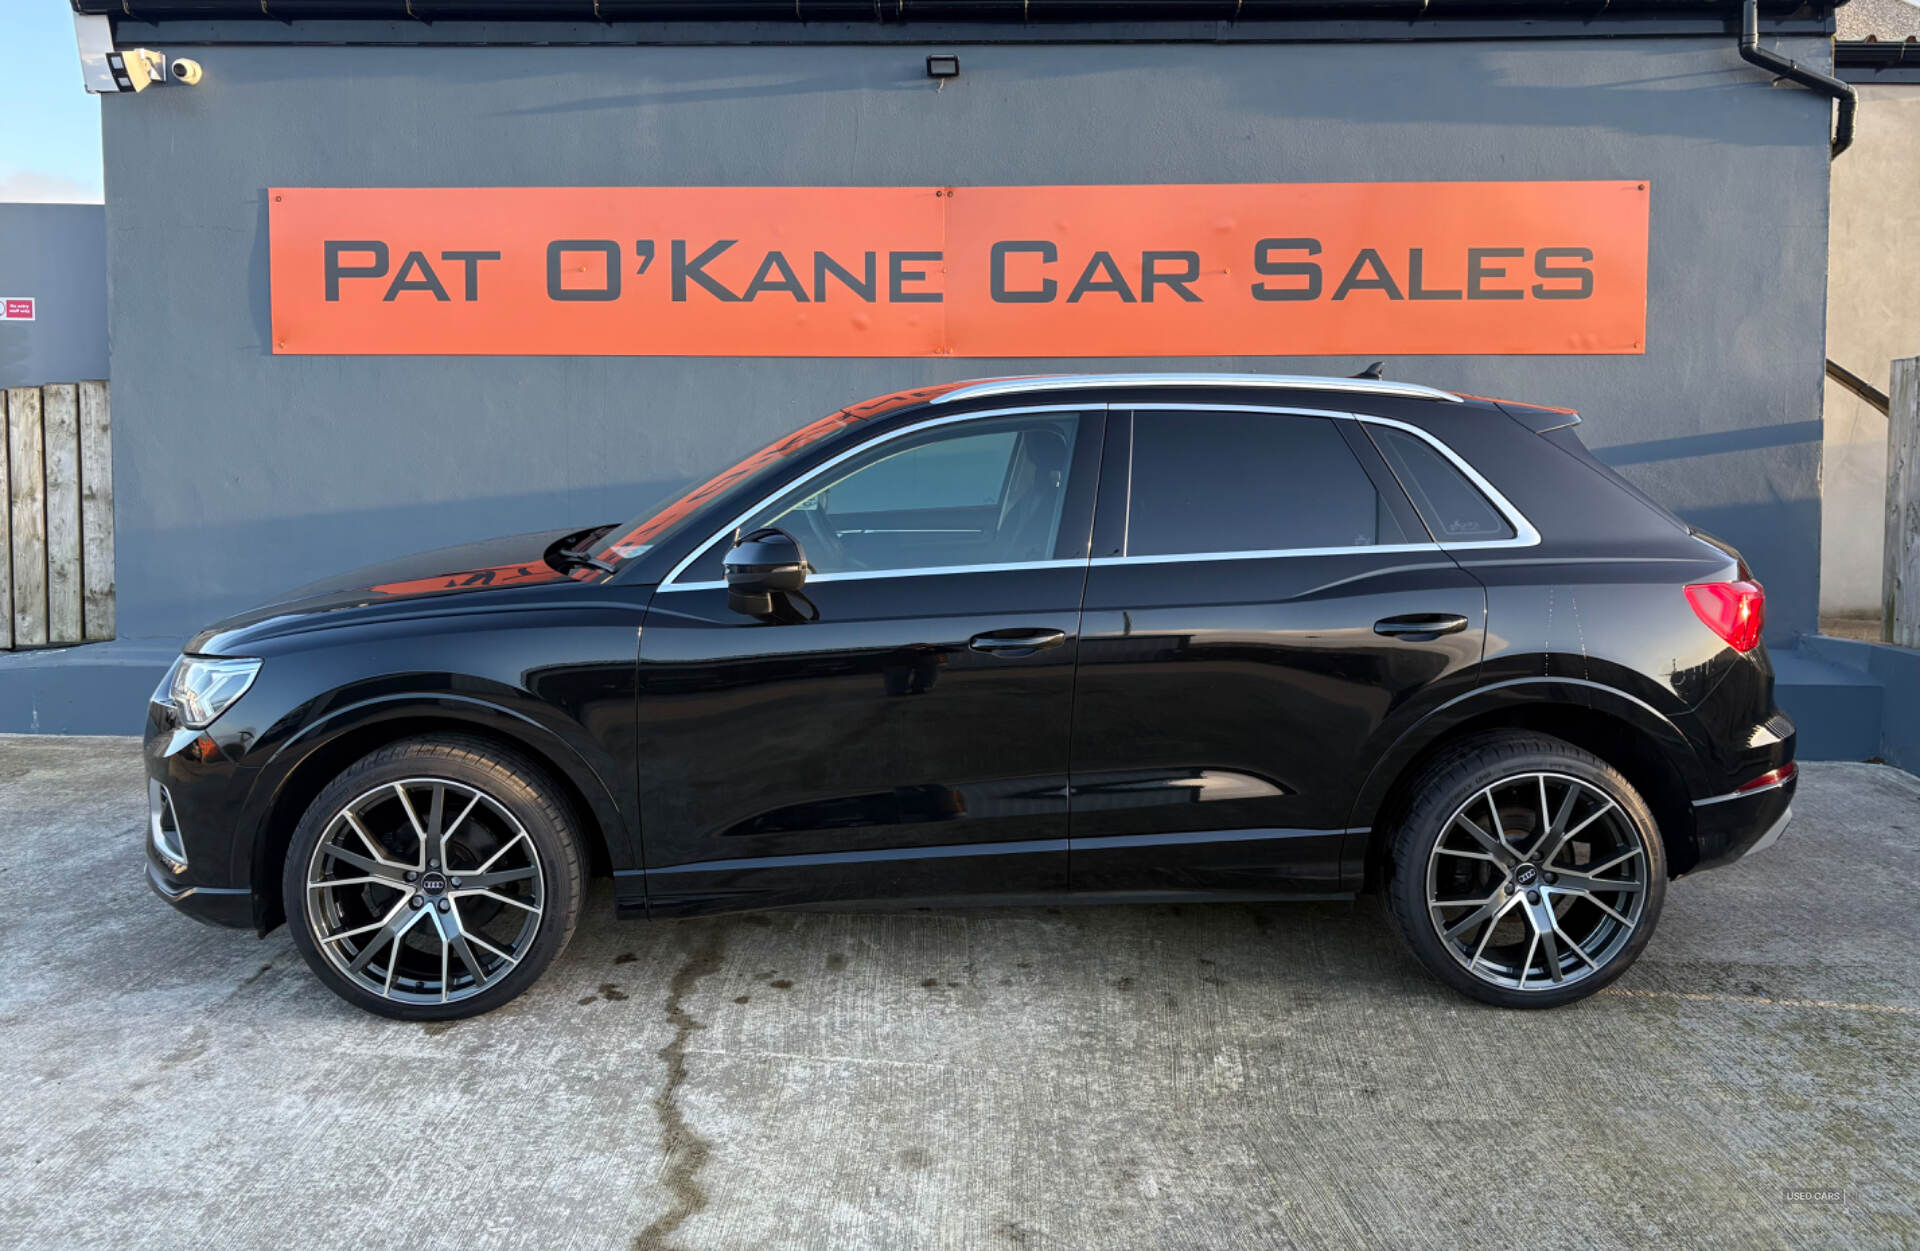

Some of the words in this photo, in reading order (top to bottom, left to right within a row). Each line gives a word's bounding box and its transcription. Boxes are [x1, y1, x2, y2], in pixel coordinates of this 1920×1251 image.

[324, 240, 502, 302] PAT
[546, 239, 944, 303] O'KANE
[990, 240, 1203, 304] CAR
[1250, 237, 1594, 302] SALES
